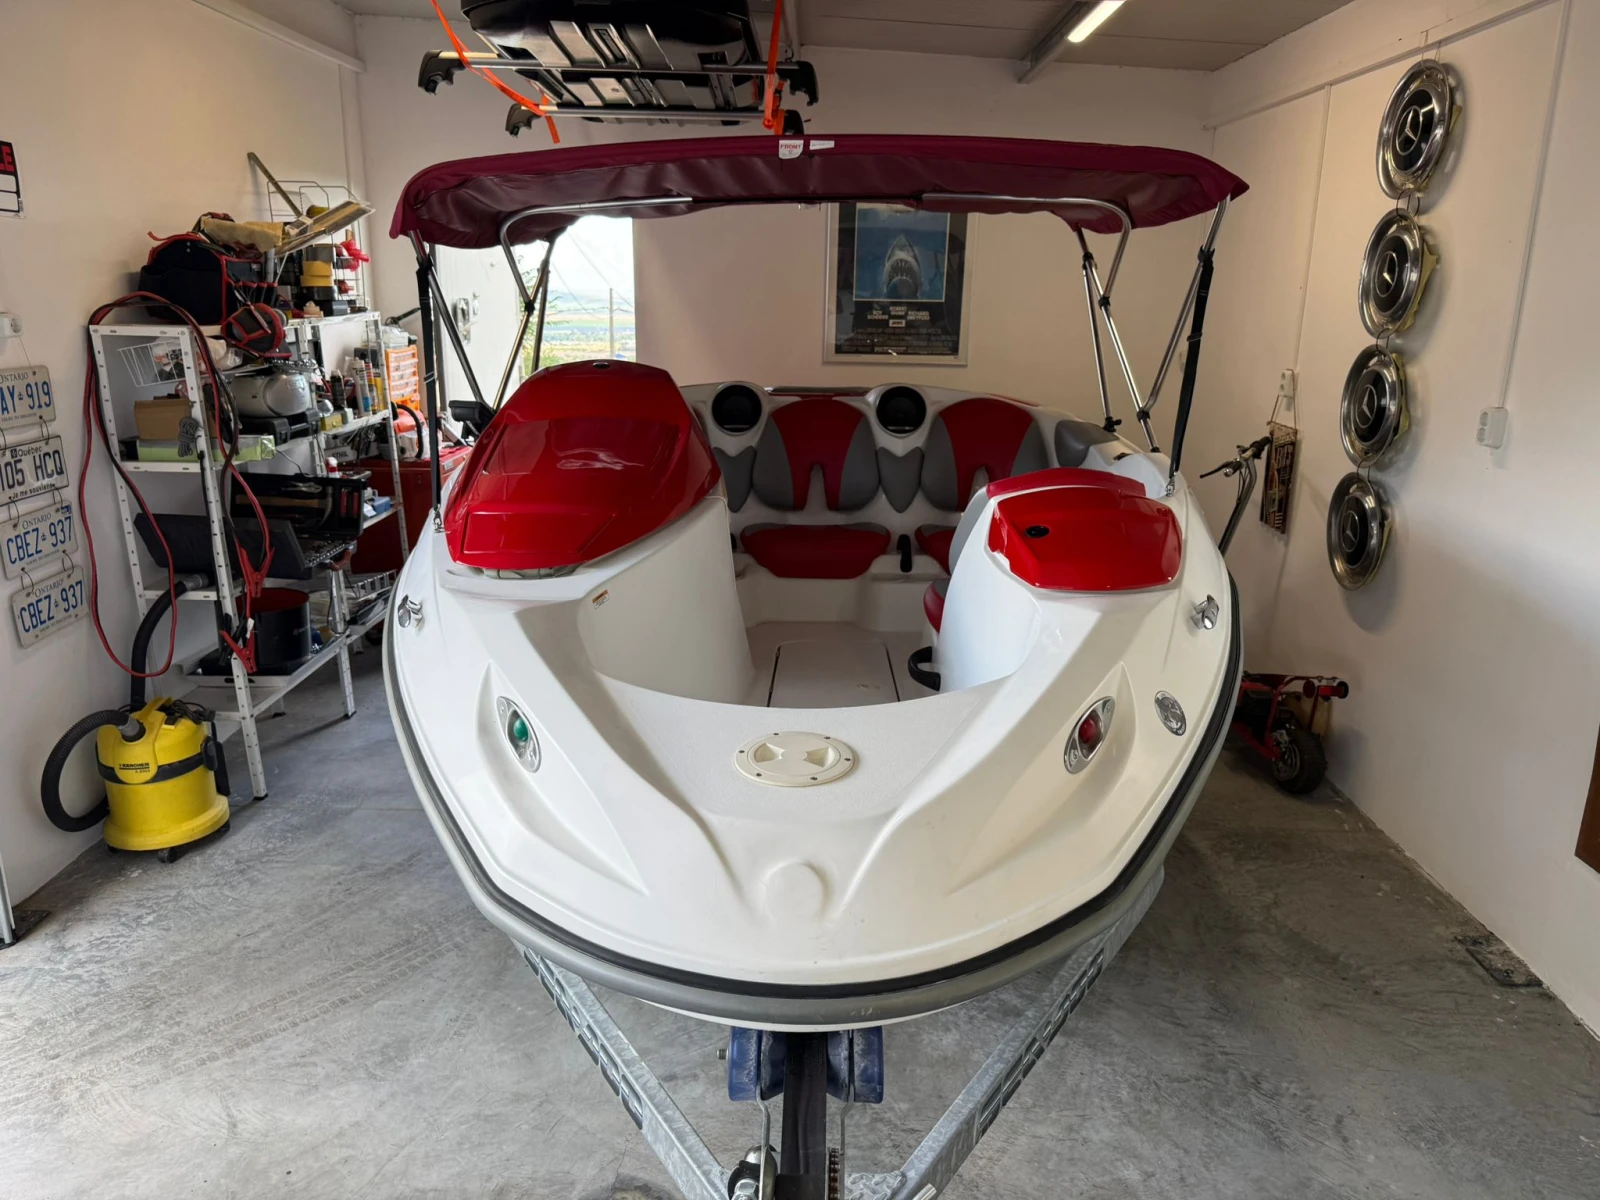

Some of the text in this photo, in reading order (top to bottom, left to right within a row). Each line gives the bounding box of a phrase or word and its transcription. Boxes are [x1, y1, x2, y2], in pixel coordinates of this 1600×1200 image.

[25, 380, 52, 410] 919
[18, 446, 43, 457] Québec
[33, 449, 65, 482] HCQ
[20, 489, 28, 497] me
[22, 512, 52, 530] ONTARIO
[7, 515, 72, 565] CBEZ 937
[35, 578, 63, 598] ONTARIO
[19, 579, 83, 633] CBEZ 937
